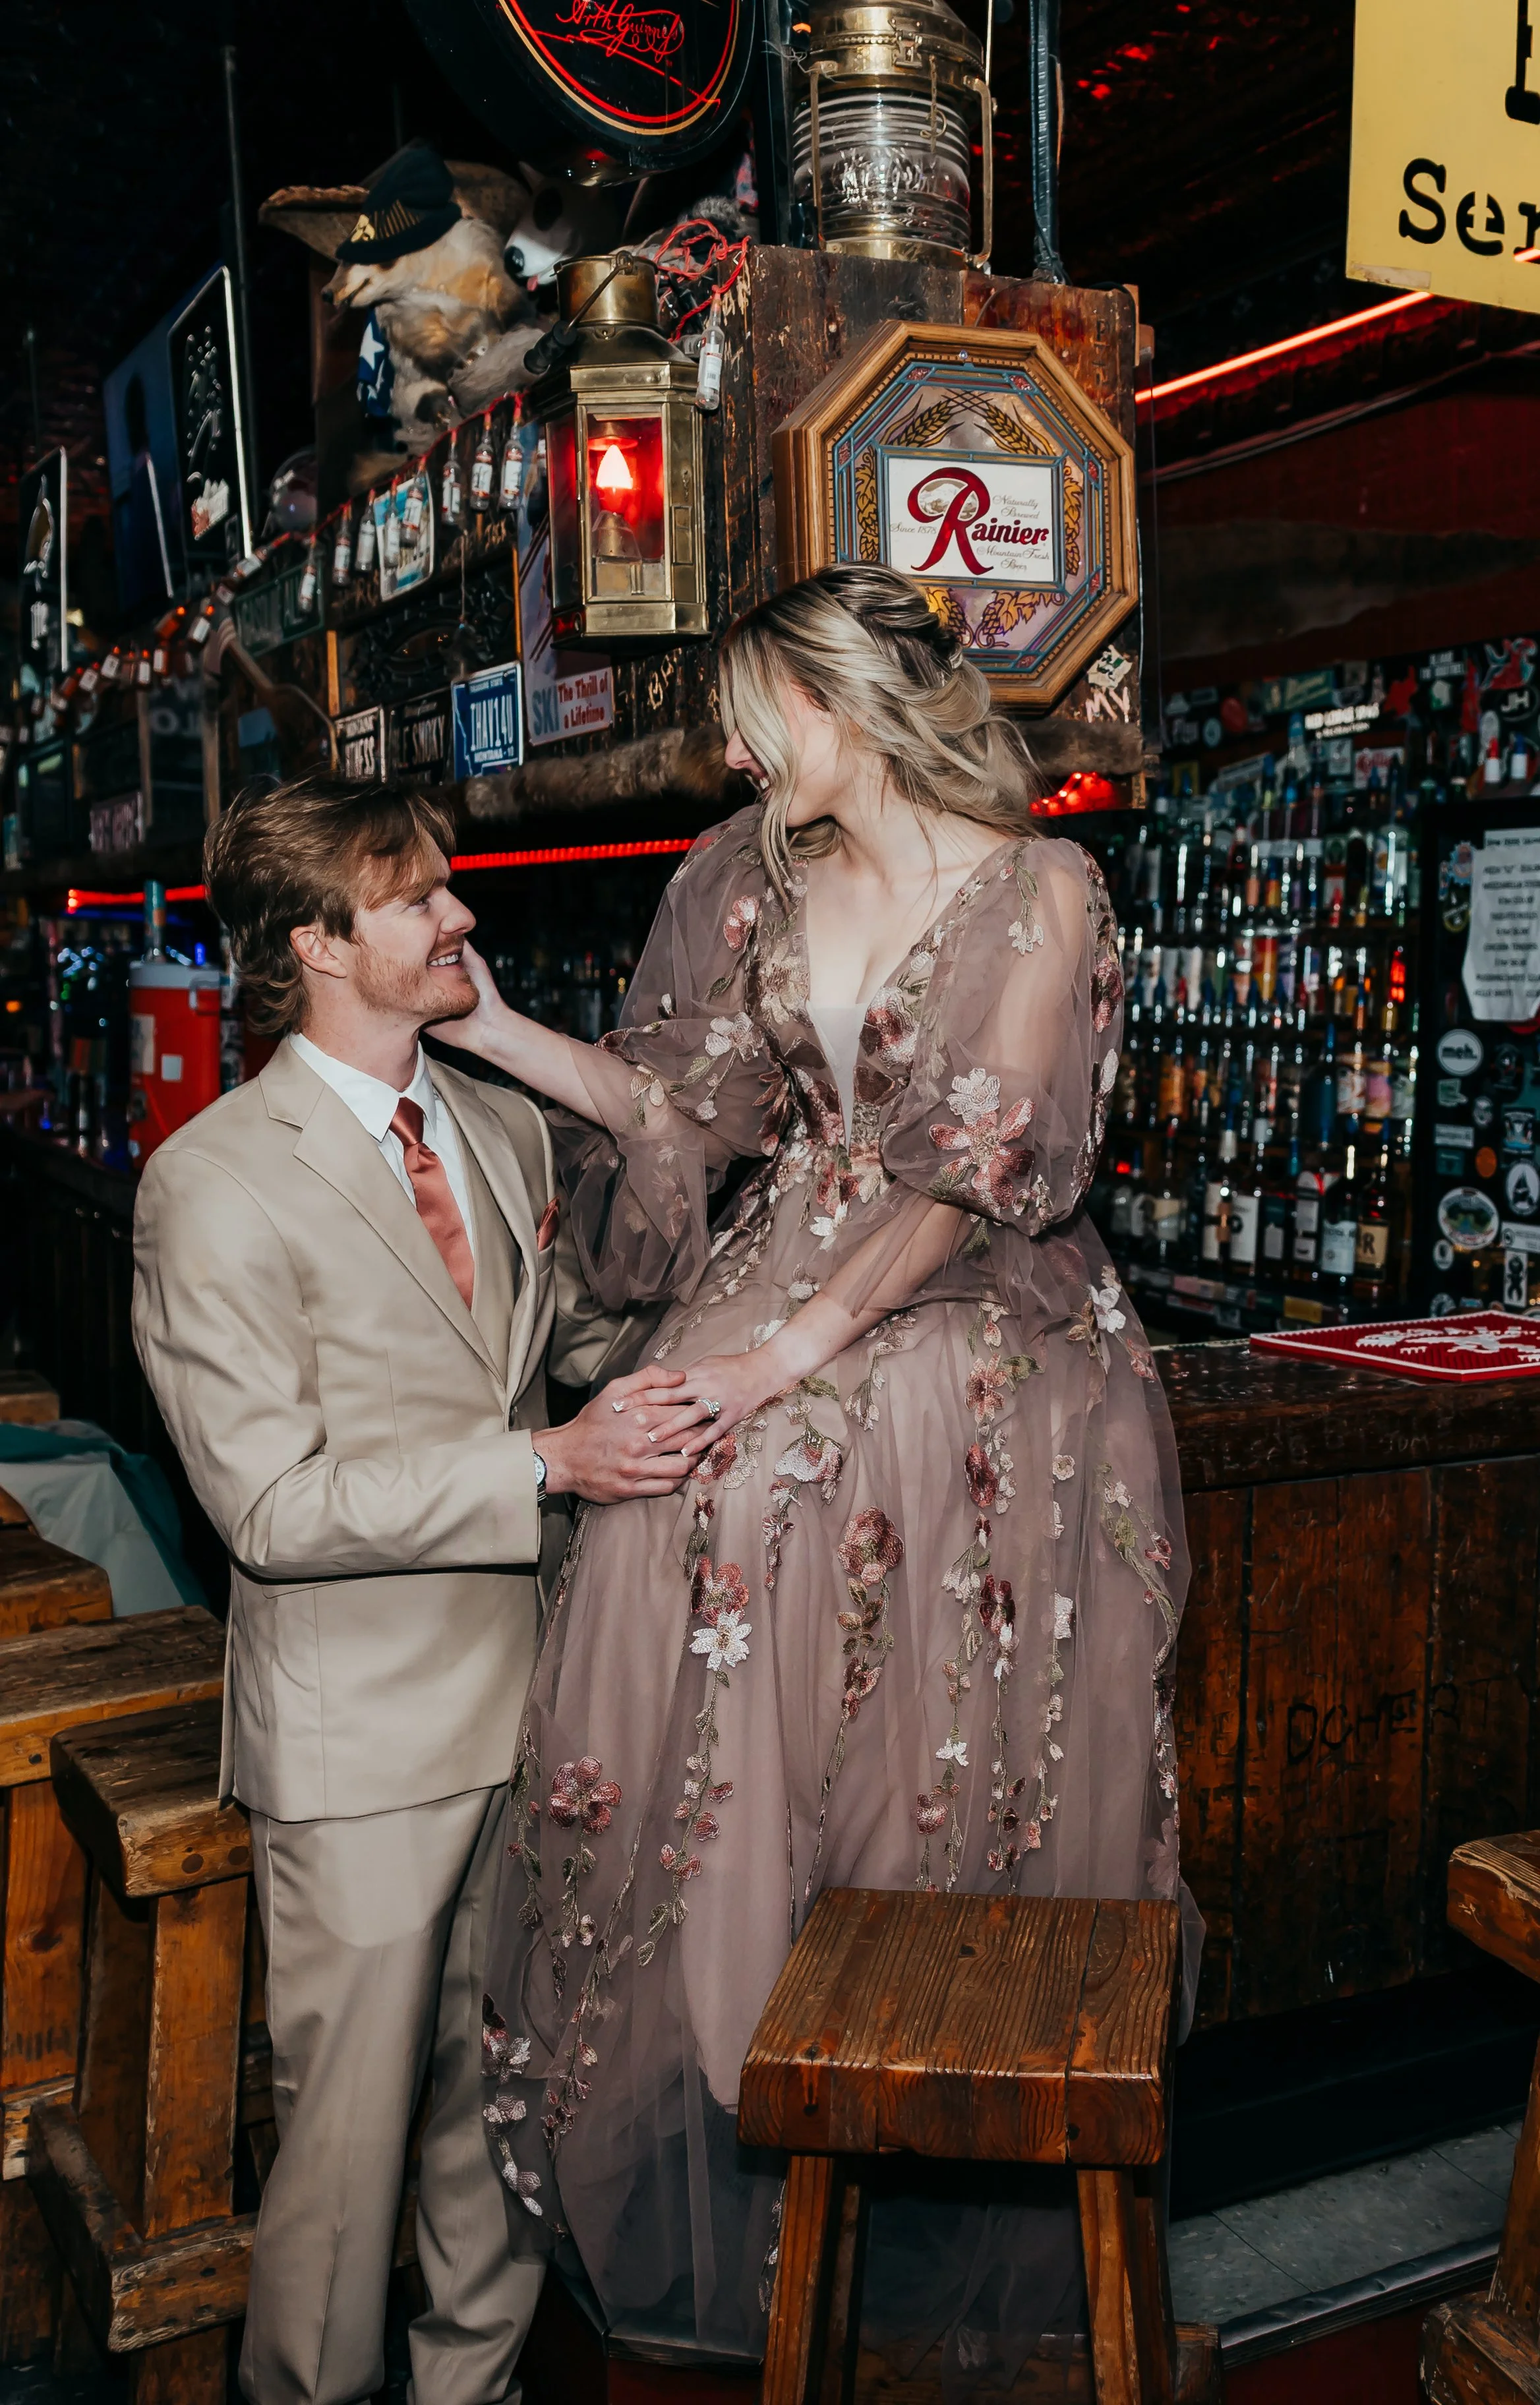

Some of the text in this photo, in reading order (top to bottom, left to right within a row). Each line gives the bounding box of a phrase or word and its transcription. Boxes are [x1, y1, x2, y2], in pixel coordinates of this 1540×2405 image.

[992, 494, 1039, 510] Naturally
[907, 467, 1050, 575] Rainier
[1001, 506, 1040, 520] Brewed
[890, 521, 937, 535] Since 1878
[976, 545, 1050, 560] Mountain Fresh
[1001, 557, 1028, 572] Beer
[558, 671, 608, 703] The Thrill of
[1500, 692, 1529, 713] JH
[532, 686, 560, 736] SKI
[564, 701, 605, 730] a Lifetime
[1441, 1043, 1478, 1059] meh.
